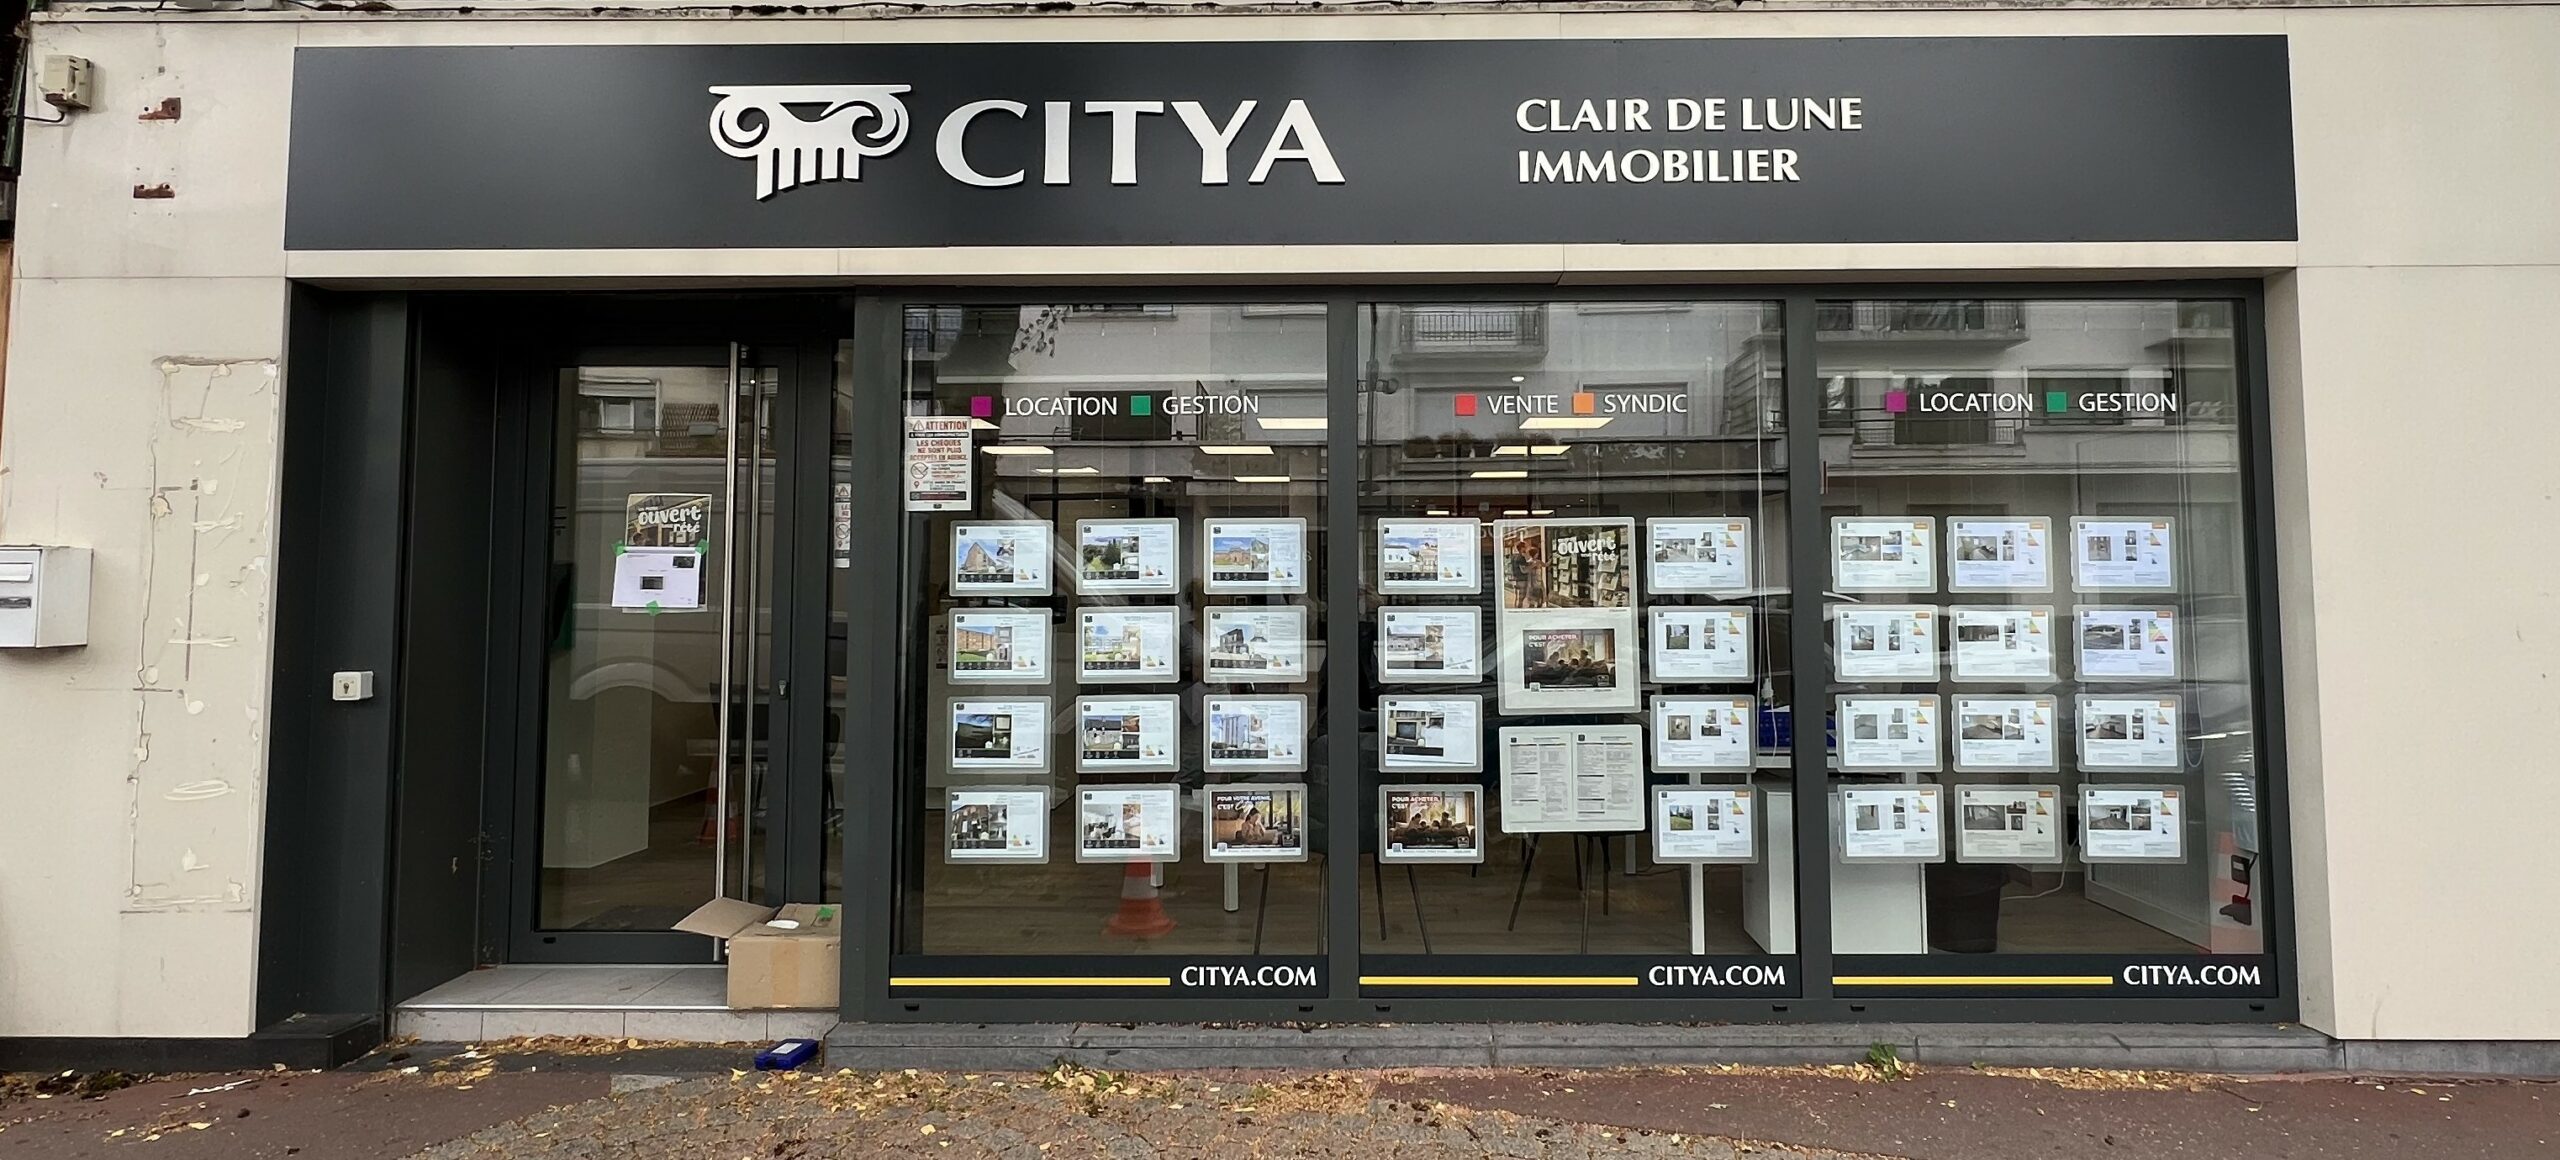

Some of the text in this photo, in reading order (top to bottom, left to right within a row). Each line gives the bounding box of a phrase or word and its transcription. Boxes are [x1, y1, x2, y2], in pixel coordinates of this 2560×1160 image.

[1516, 97, 1863, 132] CLAIR DE LUNE
[935, 99, 1346, 187] CITYA
[1518, 148, 1801, 183] IMMOBILIER
[1004, 395, 1260, 416] LOCATION GESTION
[1487, 393, 1688, 414] VENTE SYNDIC
[1919, 393, 2177, 412] LOCATION GESTION
[926, 421, 967, 430] ATTENTION
[638, 505, 702, 526] ouvert
[1557, 536, 1617, 555] ouvert
[1180, 966, 1317, 987] CITYA.COM
[1648, 965, 1786, 986] CITYA.COM
[2123, 965, 2261, 986] CITYA.COM
